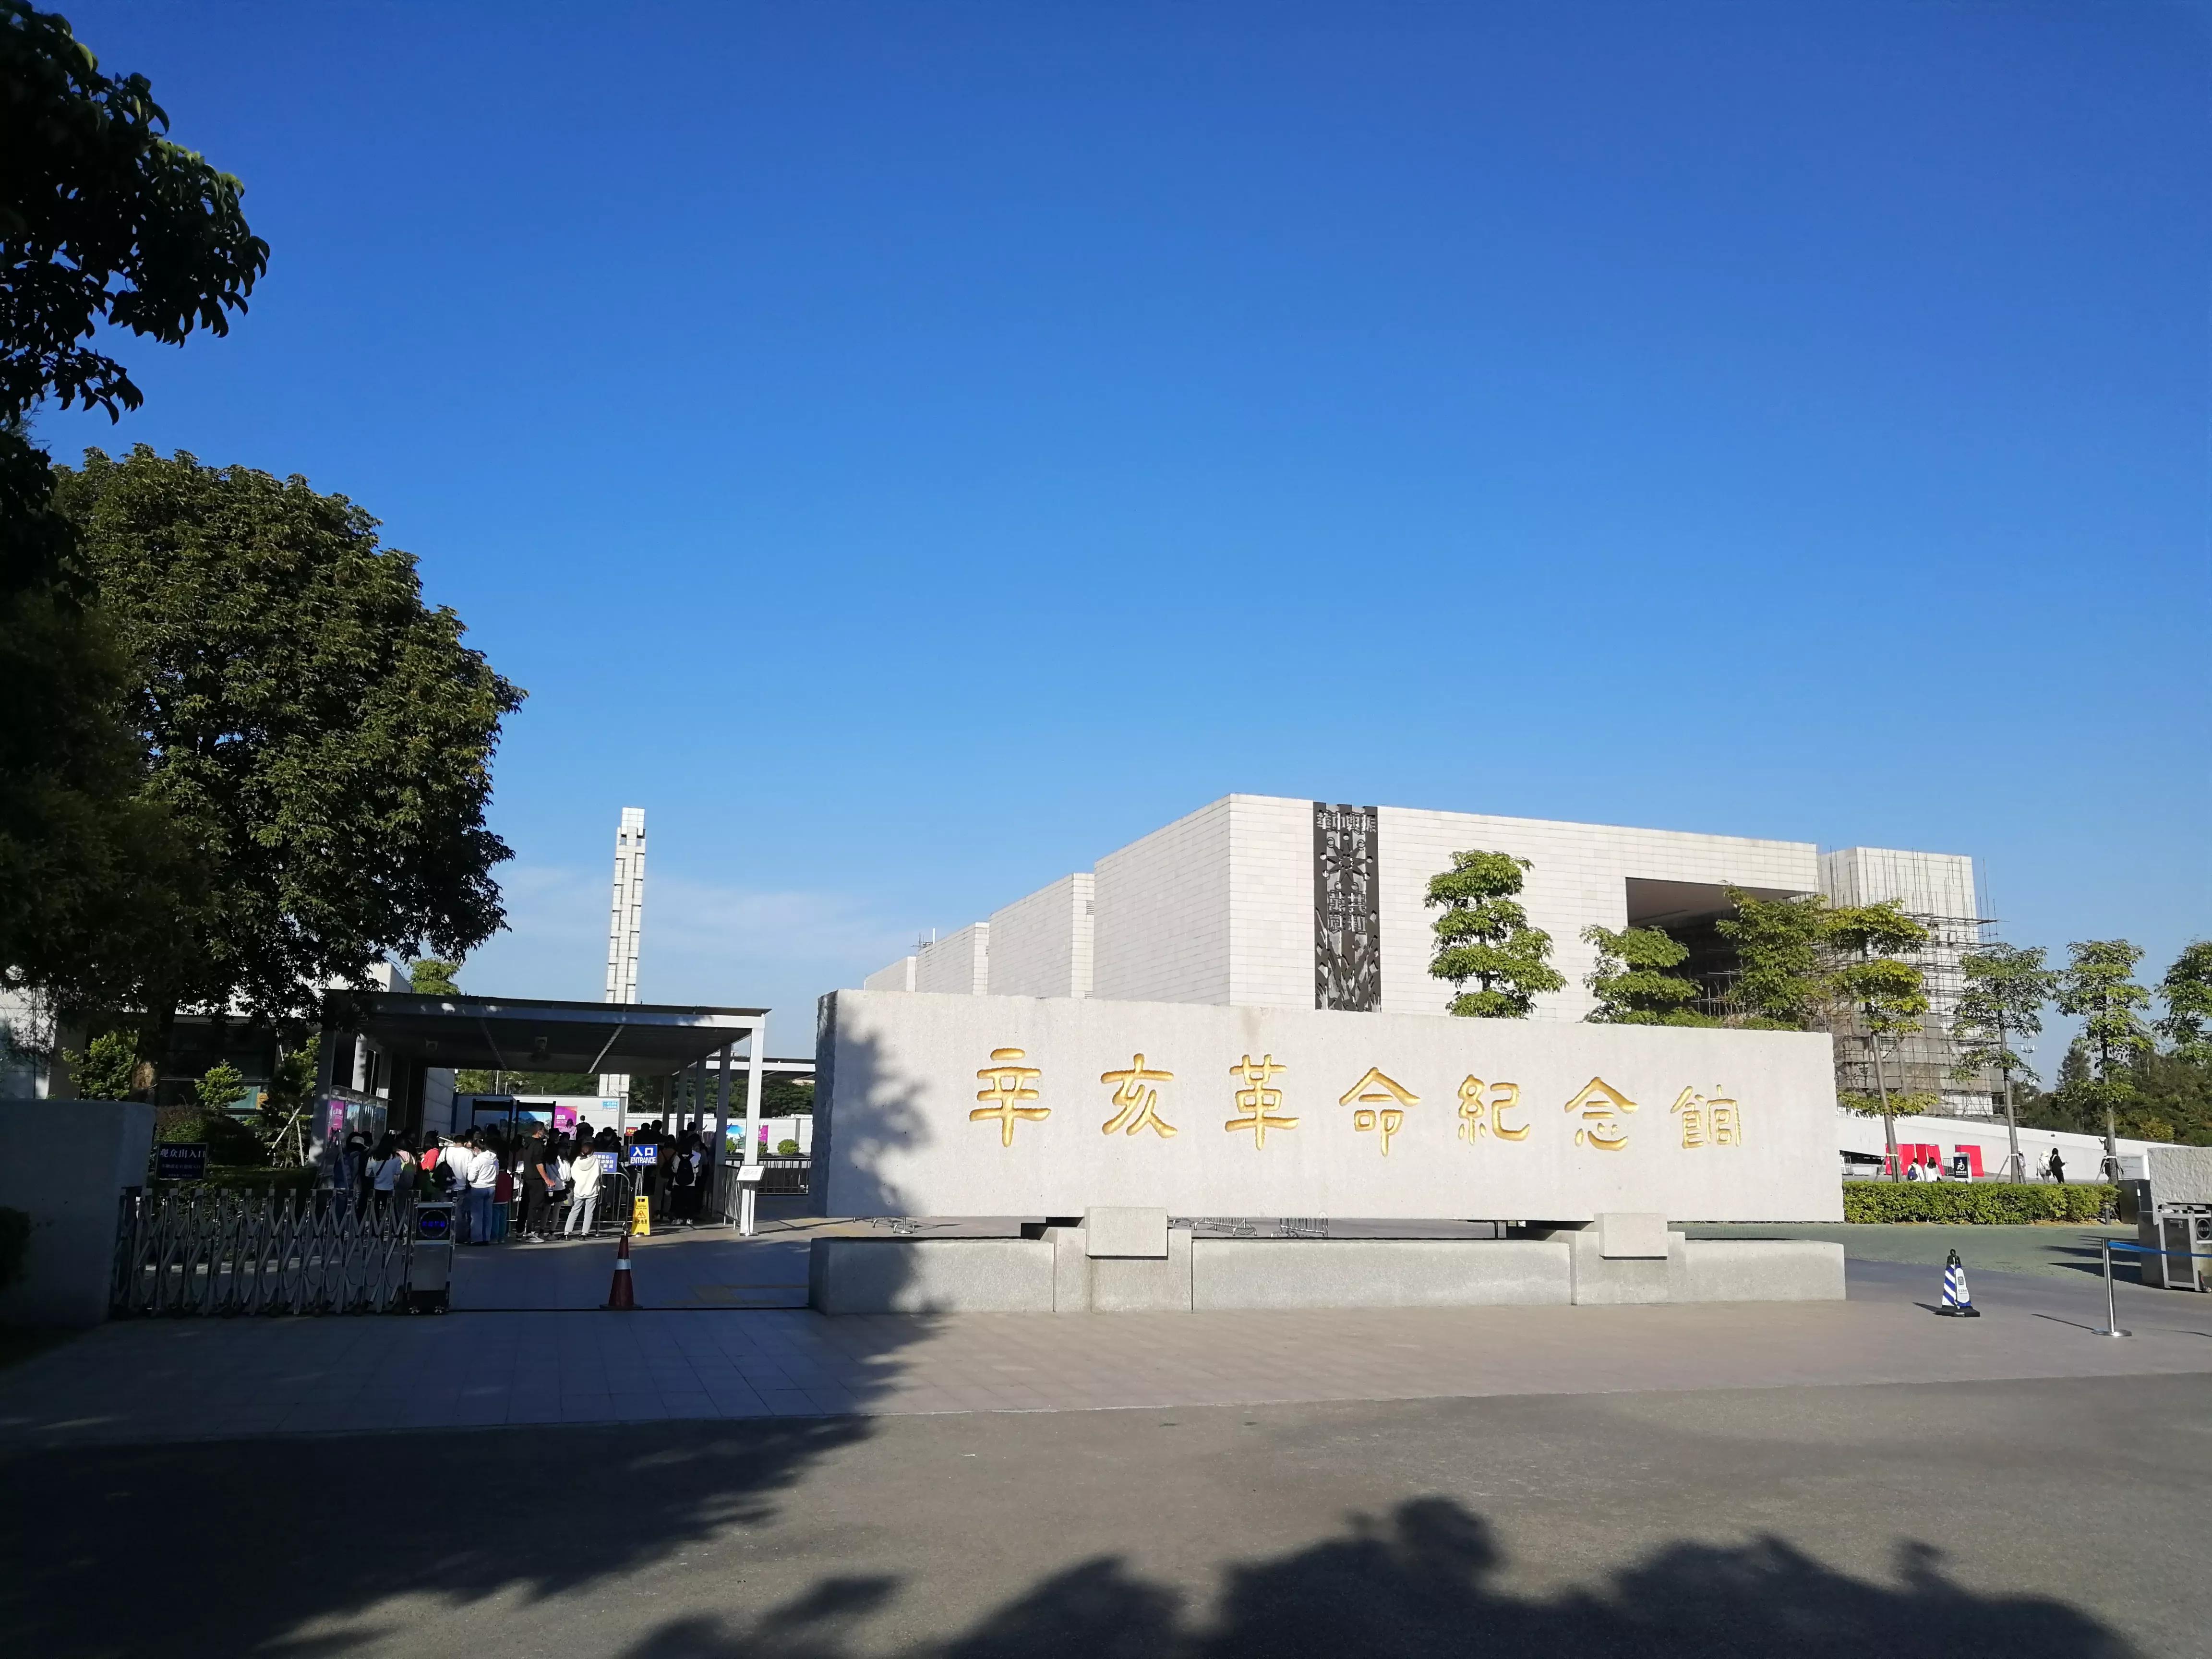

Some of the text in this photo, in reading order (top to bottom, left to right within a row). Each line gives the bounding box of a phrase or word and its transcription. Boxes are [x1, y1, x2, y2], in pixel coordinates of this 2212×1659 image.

[969, 1047, 1742, 1157] 辛亥革命紀念館
[633, 1147, 654, 1156] 入口
